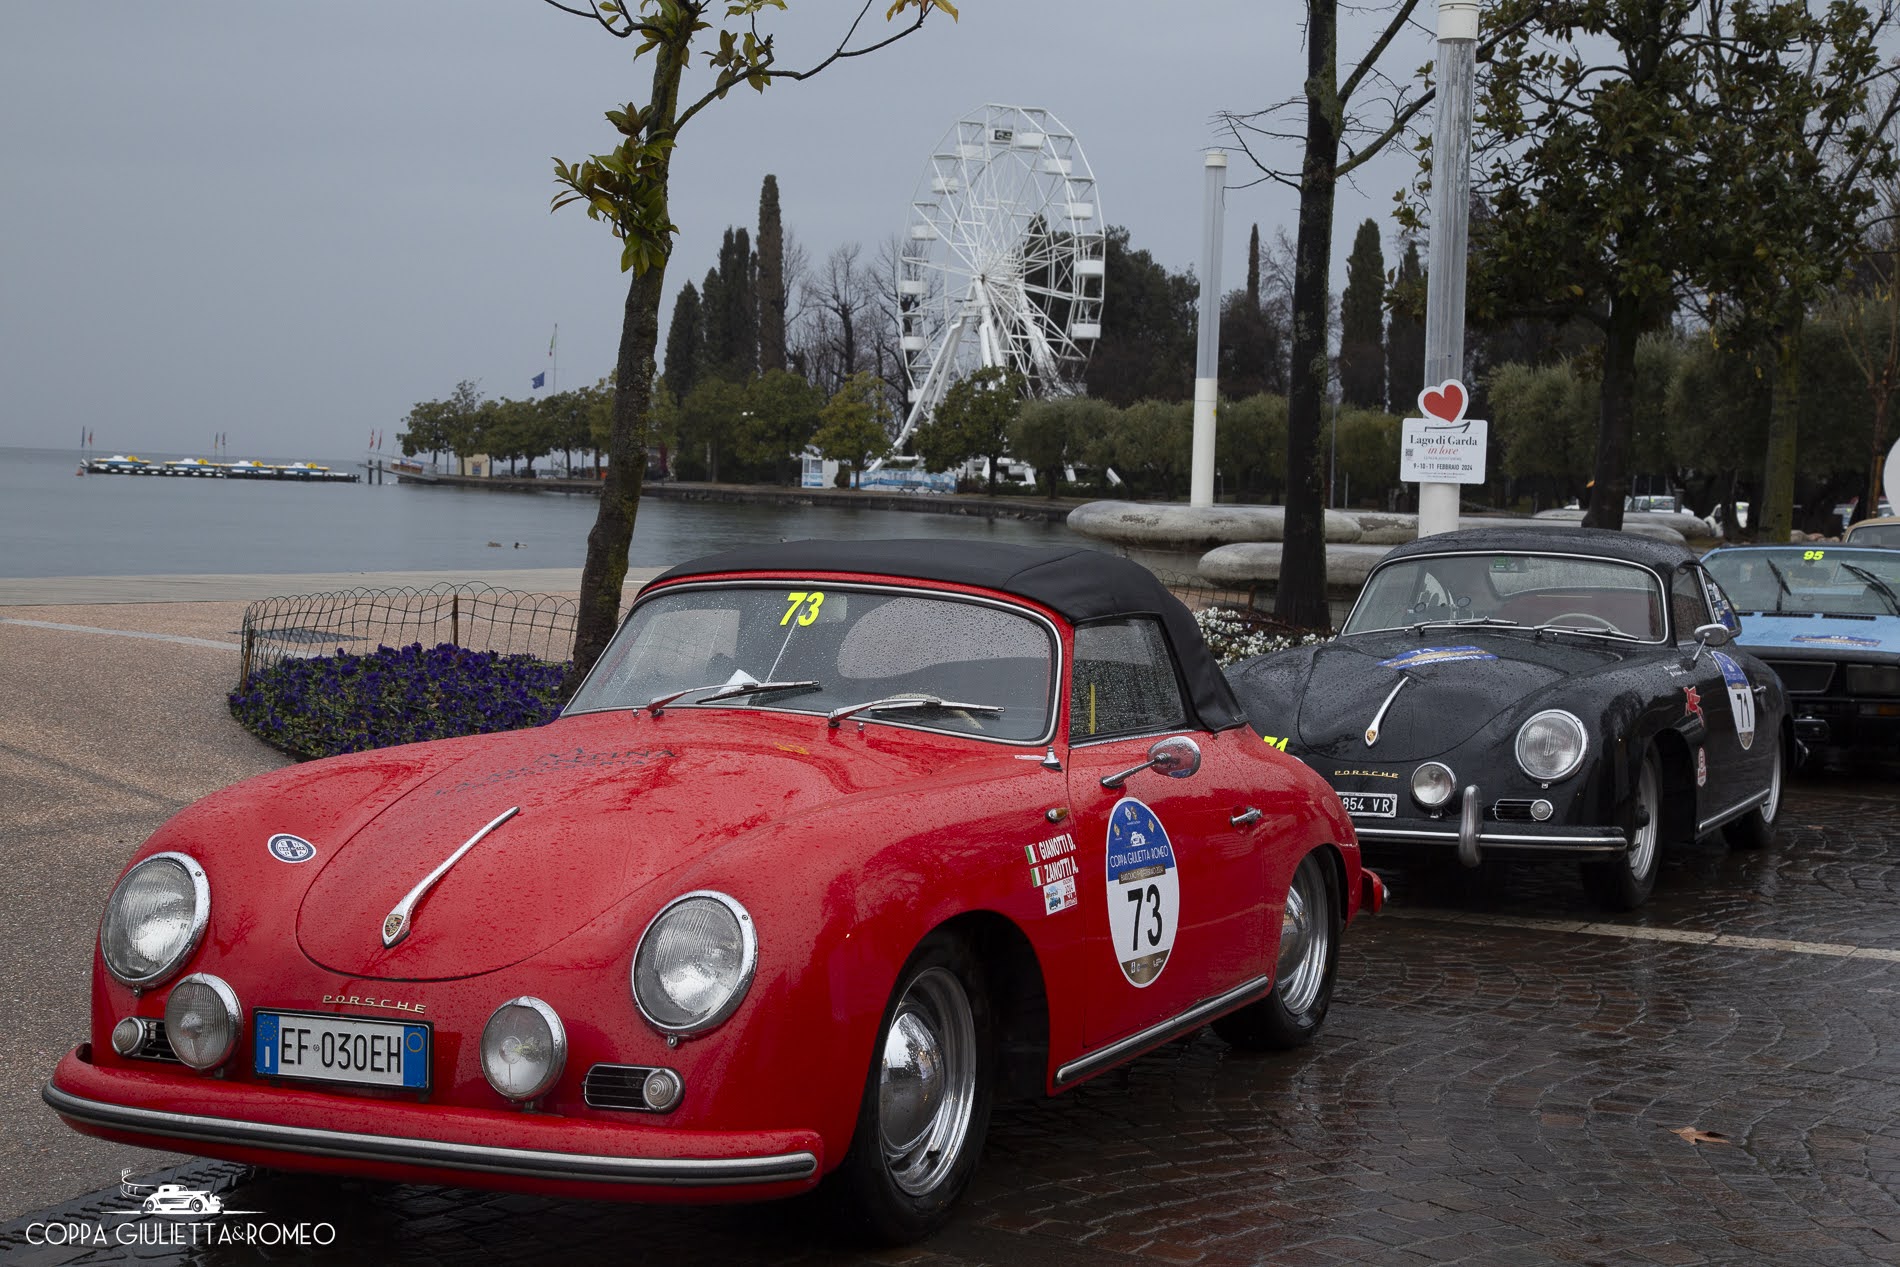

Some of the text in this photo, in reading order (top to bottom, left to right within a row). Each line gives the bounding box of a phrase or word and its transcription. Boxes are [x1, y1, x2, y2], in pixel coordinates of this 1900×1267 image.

[1410, 434, 1477, 447] Lago di Garda
[1428, 445, 1459, 455] in love
[1803, 551, 1824, 560] 95
[780, 591, 825, 627] 73
[1736, 692, 1751, 729] 71
[1334, 770, 1399, 779] PORSCHE
[1373, 798, 1390, 812] VR
[1038, 833, 1076, 860] GIANOTTI D.
[1109, 855, 1128, 868] COPPA
[1150, 845, 1169, 859] ROMEO
[1043, 855, 1079, 883] ZANOTTI A.
[1127, 884, 1163, 951] 73
[322, 995, 427, 1014] PORSCHE
[281, 1027, 402, 1074] EF 030EH
